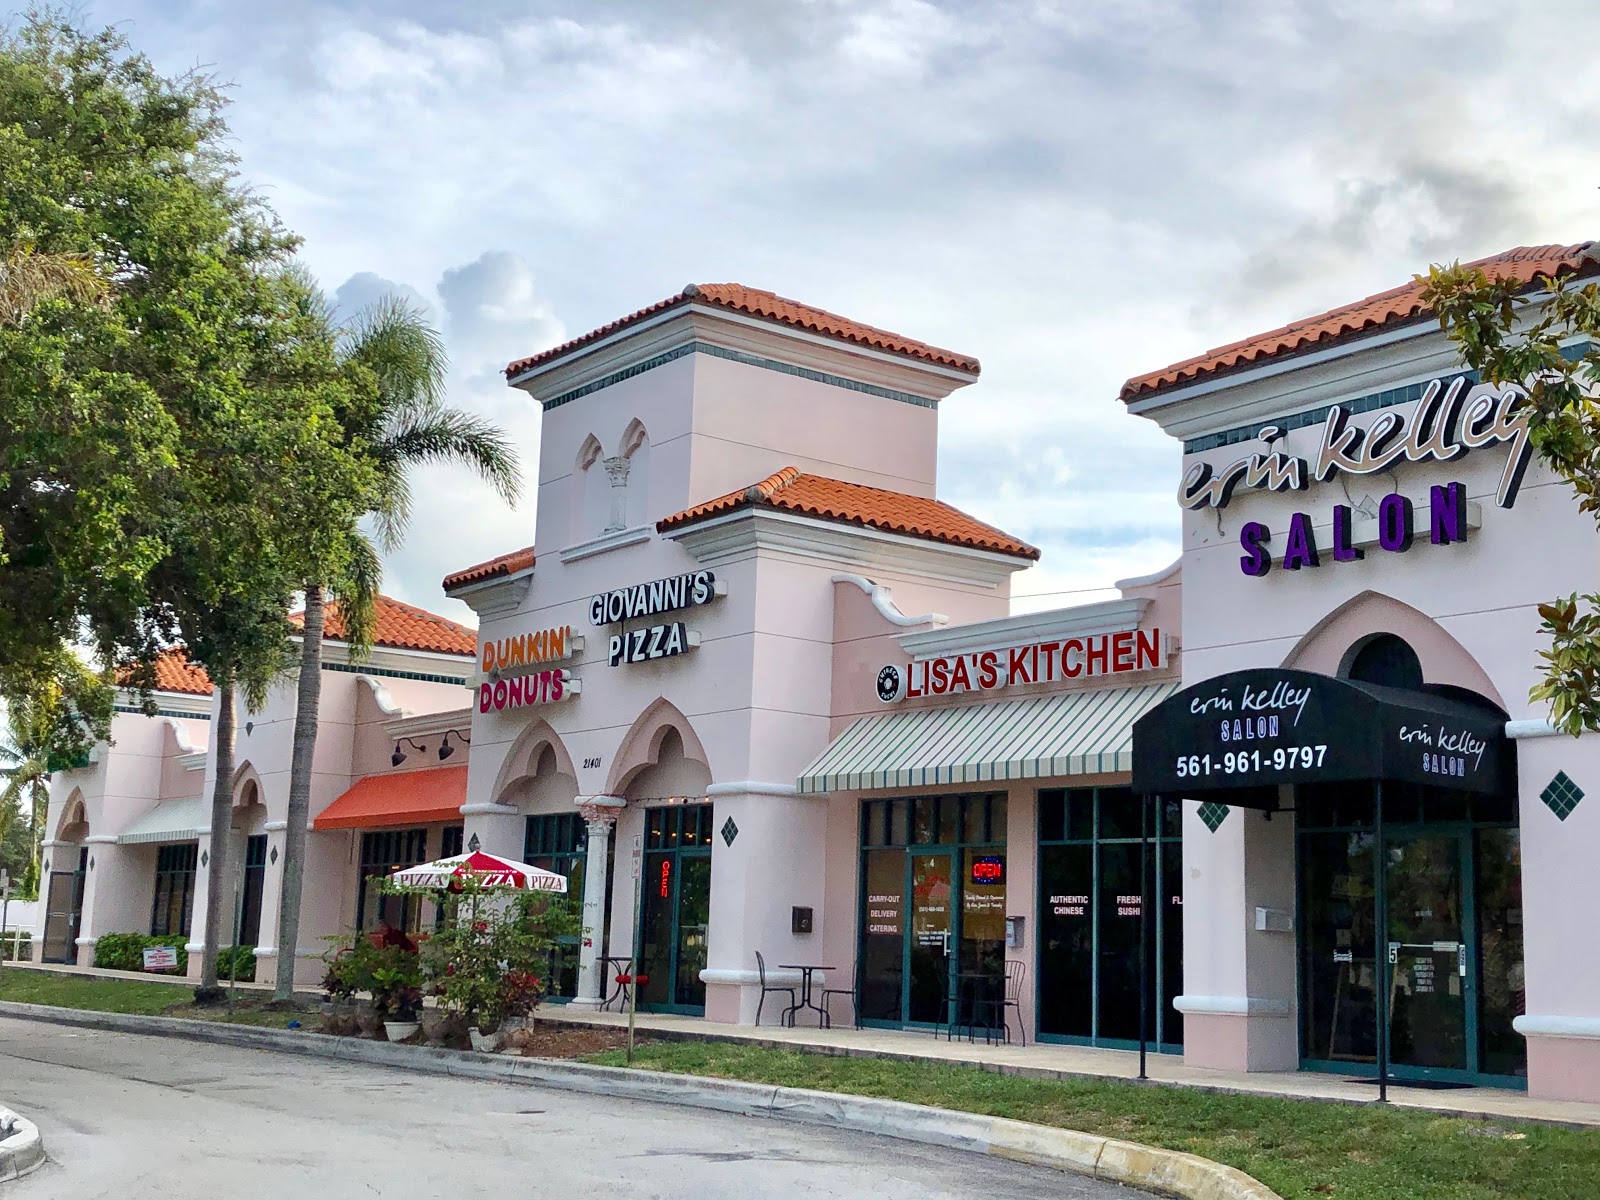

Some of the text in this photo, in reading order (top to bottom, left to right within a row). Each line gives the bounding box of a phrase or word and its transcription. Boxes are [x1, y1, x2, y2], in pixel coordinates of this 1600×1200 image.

[1177, 375, 1533, 510] erin kelley
[1240, 481, 1466, 577] SALON
[588, 571, 712, 626] GIOVANNI'S
[481, 625, 571, 673] DUNKIN'
[607, 622, 686, 667] PIZZA
[905, 627, 1161, 699] LISA'S KITCHEN
[480, 668, 564, 714] DONUTS
[1191, 680, 1311, 727] erin kelley
[1220, 714, 1280, 742] SALON
[1399, 723, 1486, 771] erin kelley
[583, 757, 601, 768] 21401
[1176, 744, 1328, 778] 561-961-9797
[1422, 752, 1465, 777] SALON
[973, 863, 1001, 877] OPEN
[401, 873, 444, 886] PIZZA
[461, 873, 516, 888] PZZA
[531, 876, 562, 890] PIZZA
[661, 861, 670, 897] OPEN
[869, 895, 900, 903] CARRY-OUT
[1050, 895, 1088, 904] AUTHENTIC
[1116, 895, 1142, 904] FRESH
[1172, 896, 1183, 904] FL
[870, 910, 897, 918] DELIVERY
[1054, 907, 1084, 915] CHINESE
[1118, 907, 1141, 916] SUSHI
[869, 924, 897, 933] CATERING
[1390, 948, 1396, 962] 5
